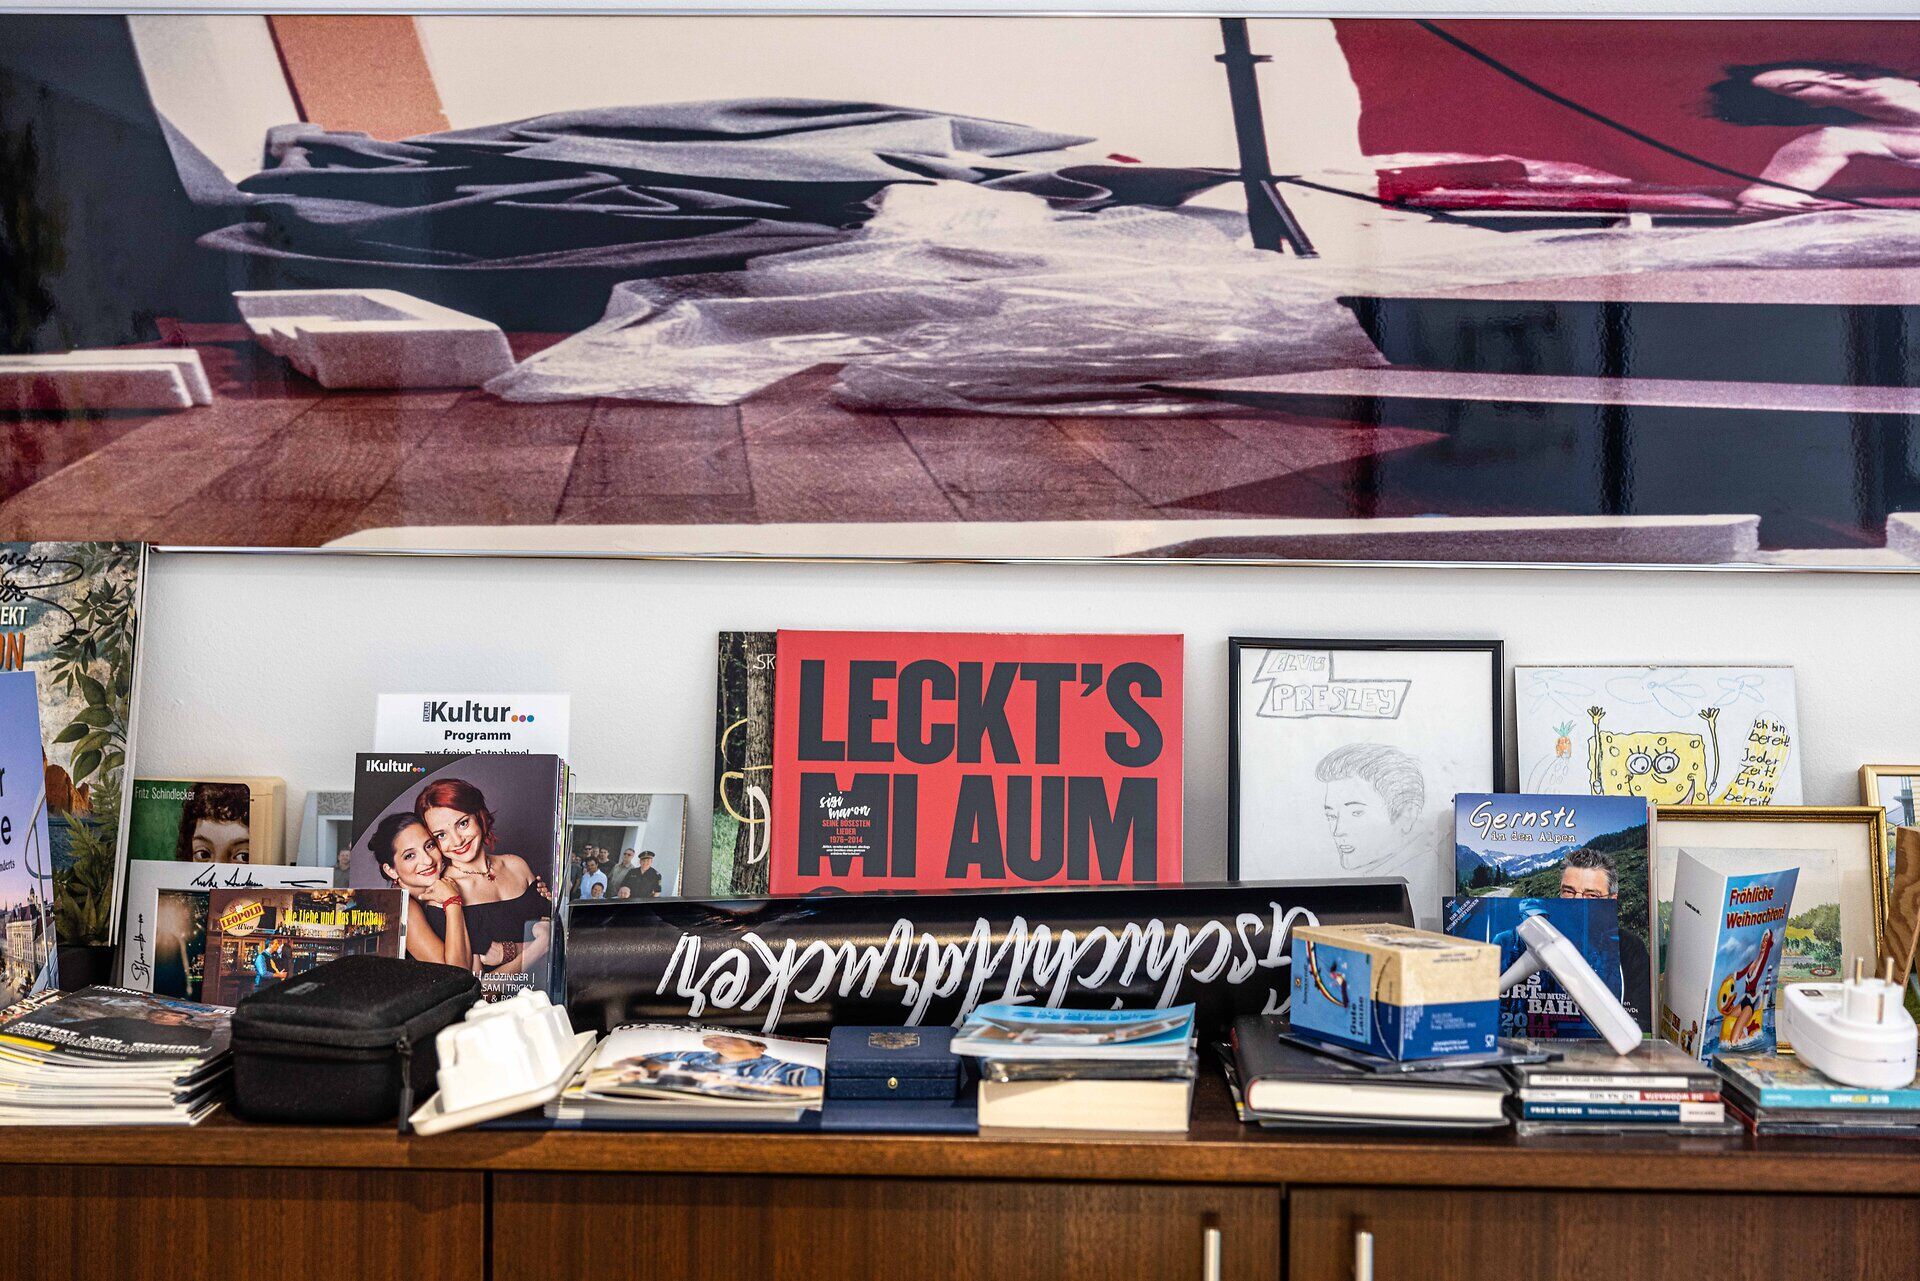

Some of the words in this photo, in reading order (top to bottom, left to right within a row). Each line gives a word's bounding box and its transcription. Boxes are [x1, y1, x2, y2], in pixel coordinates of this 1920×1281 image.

[1272, 683, 1396, 715] PRESLEY
[797, 659, 1164, 768] LECKT’S
[1753, 719, 1768, 729] Ich
[1772, 720, 1785, 734] bin
[444, 729, 511, 743] Programm
[1748, 729, 1791, 748] bereit!
[1741, 747, 1779, 766] Jeder
[1735, 772, 1755, 790] Ich
[1757, 780, 1775, 795] bin
[135, 786, 150, 799] Fritz
[151, 786, 196, 801] Schindlecker
[820, 791, 844, 809] sigi
[828, 805, 871, 820] maron
[1469, 800, 1577, 840] Gernstl
[797, 772, 919, 879] MI
[945, 774, 1159, 882] AUM
[822, 819, 839, 828] SEINE
[836, 827, 857, 836] LIEDER
[1491, 831, 1506, 841] in
[1511, 831, 1533, 841] den
[1539, 831, 1576, 844] Alpen
[1729, 885, 1775, 907] Fröhliche
[220, 903, 263, 929] LEOPOLD
[299, 909, 320, 925] Liebe
[320, 909, 335, 925] und
[337, 909, 350, 925] das
[1726, 902, 1787, 929] Weihnachten!
[235, 922, 254, 931] Wien
[481, 983, 501, 992] SAM
[1501, 1012, 1528, 1027] 20
